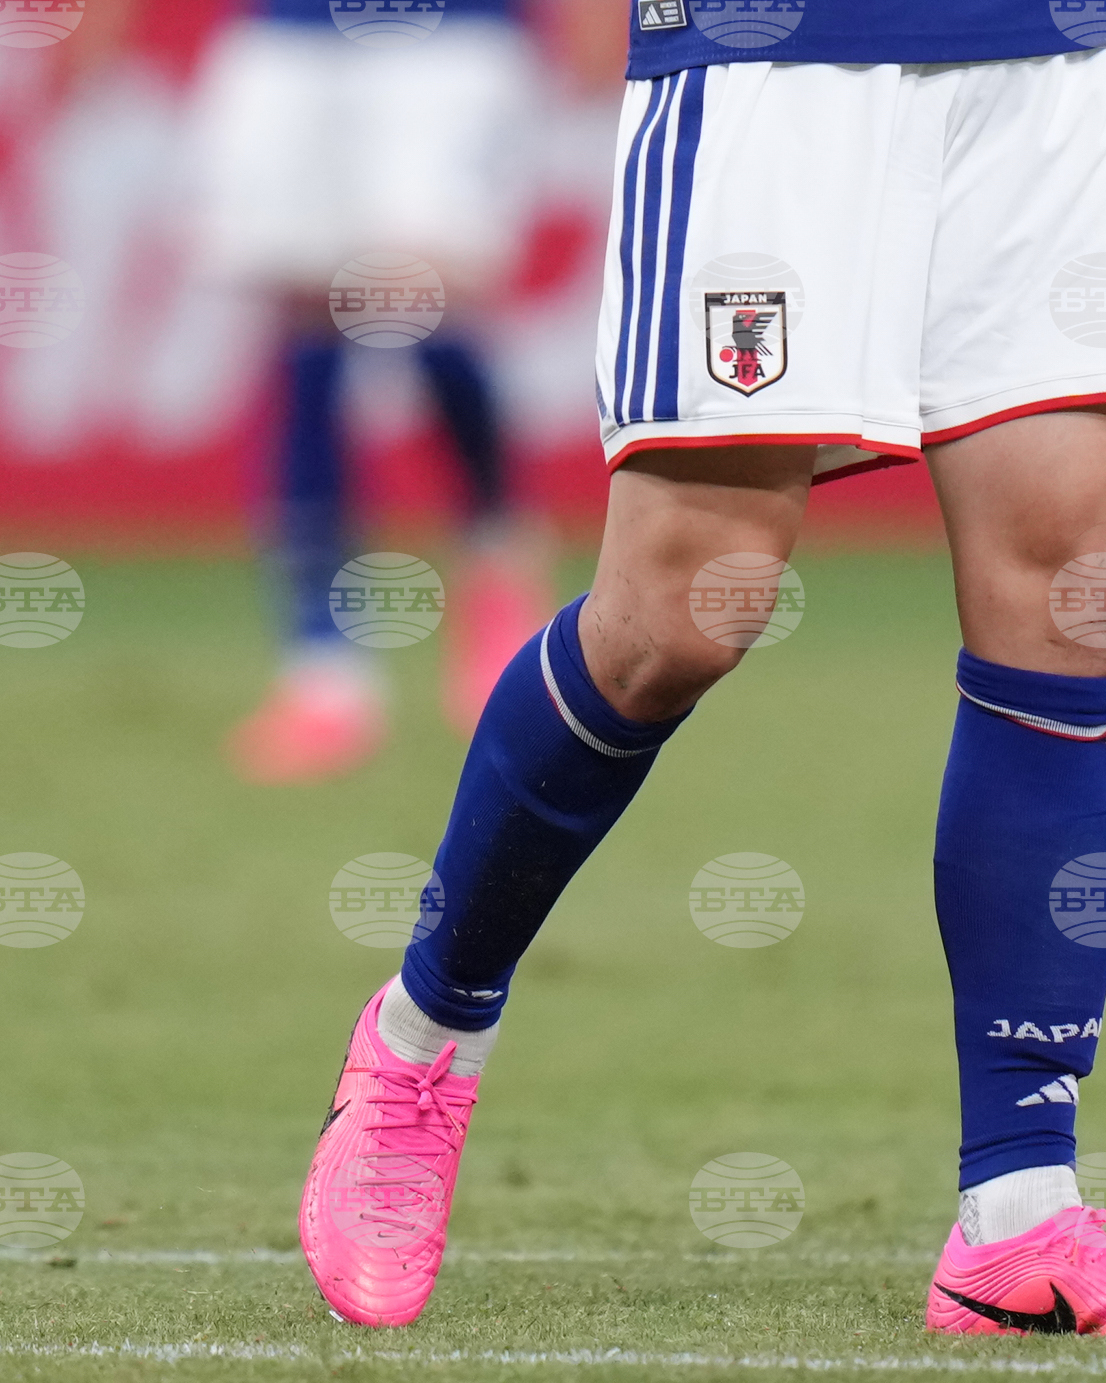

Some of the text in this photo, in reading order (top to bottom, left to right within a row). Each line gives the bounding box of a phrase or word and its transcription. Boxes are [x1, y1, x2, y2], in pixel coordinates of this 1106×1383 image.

[724, 294, 767, 304] JAPAN
[729, 363, 766, 379] JFA
[987, 1017, 1103, 1043] JAPA
